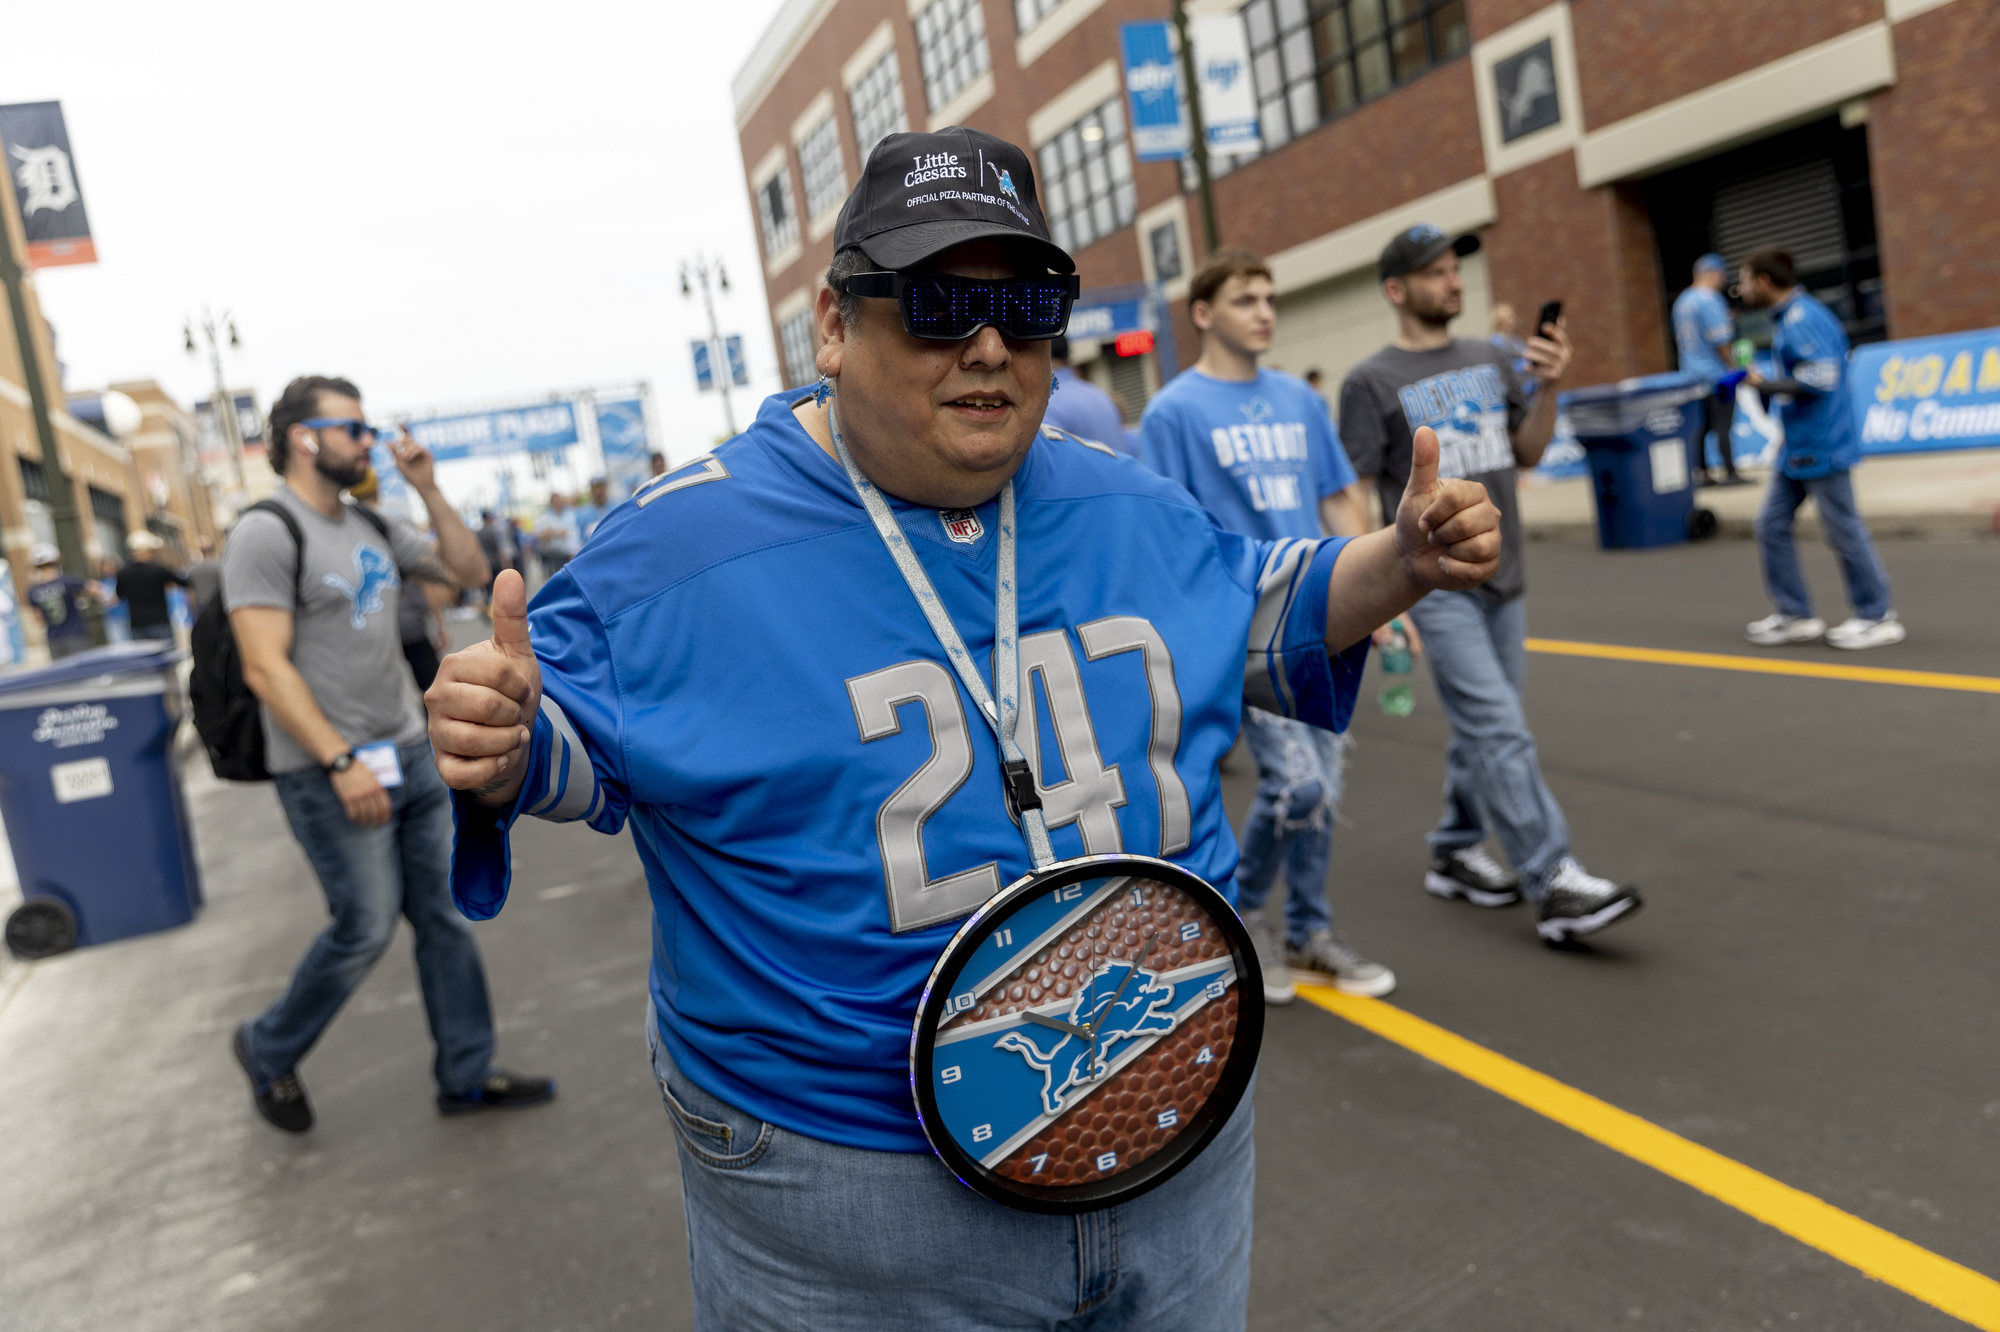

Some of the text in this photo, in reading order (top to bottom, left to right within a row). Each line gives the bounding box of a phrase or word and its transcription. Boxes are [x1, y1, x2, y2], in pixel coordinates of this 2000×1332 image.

[913, 152, 958, 173] Little
[904, 166, 967, 188] Caesars
[907, 193, 939, 207] OFFICIAL
[940, 190, 961, 200] PIZZA
[962, 192, 996, 204] PARTNER
[997, 198, 1006, 207] OF
[913, 288, 1060, 322] LIONS
[1943, 350, 1973, 396] A
[1862, 403, 1908, 442] No
[1211, 423, 1307, 467] DETROIT
[950, 520, 978, 537] NFL
[844, 616, 1192, 934] 247
[1053, 882, 1083, 904] 12
[1132, 887, 1143, 907] 1
[993, 927, 1014, 949] 11
[1180, 921, 1202, 943] 2
[1205, 979, 1226, 1001] 3
[943, 991, 977, 1016] 10
[1195, 1046, 1213, 1066] 4
[941, 1064, 962, 1085] 9
[1157, 1108, 1178, 1130] 5
[971, 1123, 993, 1144] 8
[1030, 1152, 1050, 1175] 7
[1095, 1151, 1118, 1172] 6
